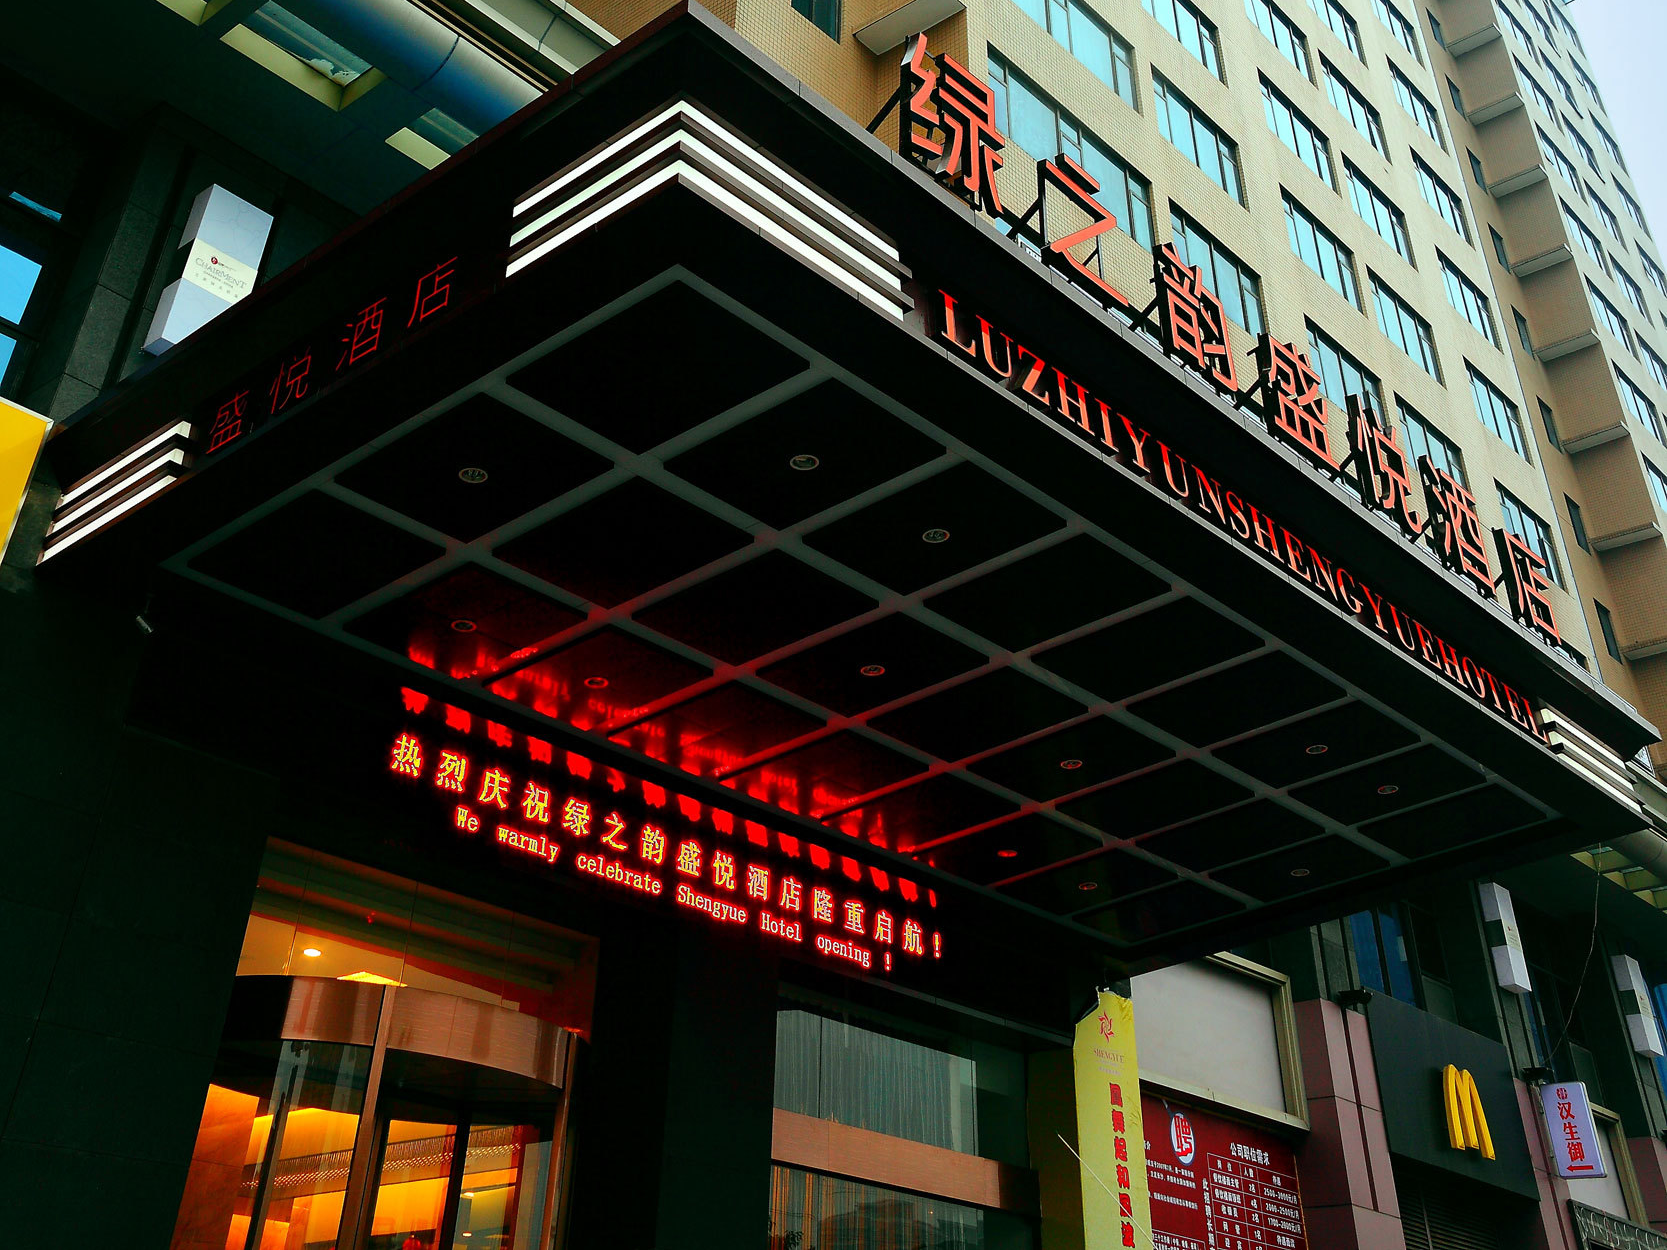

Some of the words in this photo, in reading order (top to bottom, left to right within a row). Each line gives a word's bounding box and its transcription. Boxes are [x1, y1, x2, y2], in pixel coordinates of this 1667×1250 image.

[206, 256, 457, 455] 盛悦酒店
[907, 33, 1561, 644] 绿之韵盛悦酒店
[937, 289, 1549, 744] LUZHIYUNSHENGYUEHOTEL
[456, 806, 479, 833] We
[498, 824, 559, 863] warmly
[577, 853, 663, 895] celebrate
[677, 883, 747, 925] Shengyue
[760, 911, 802, 942] Hotel
[817, 936, 871, 968] opening
[1173, 1115, 1193, 1157] 聘
